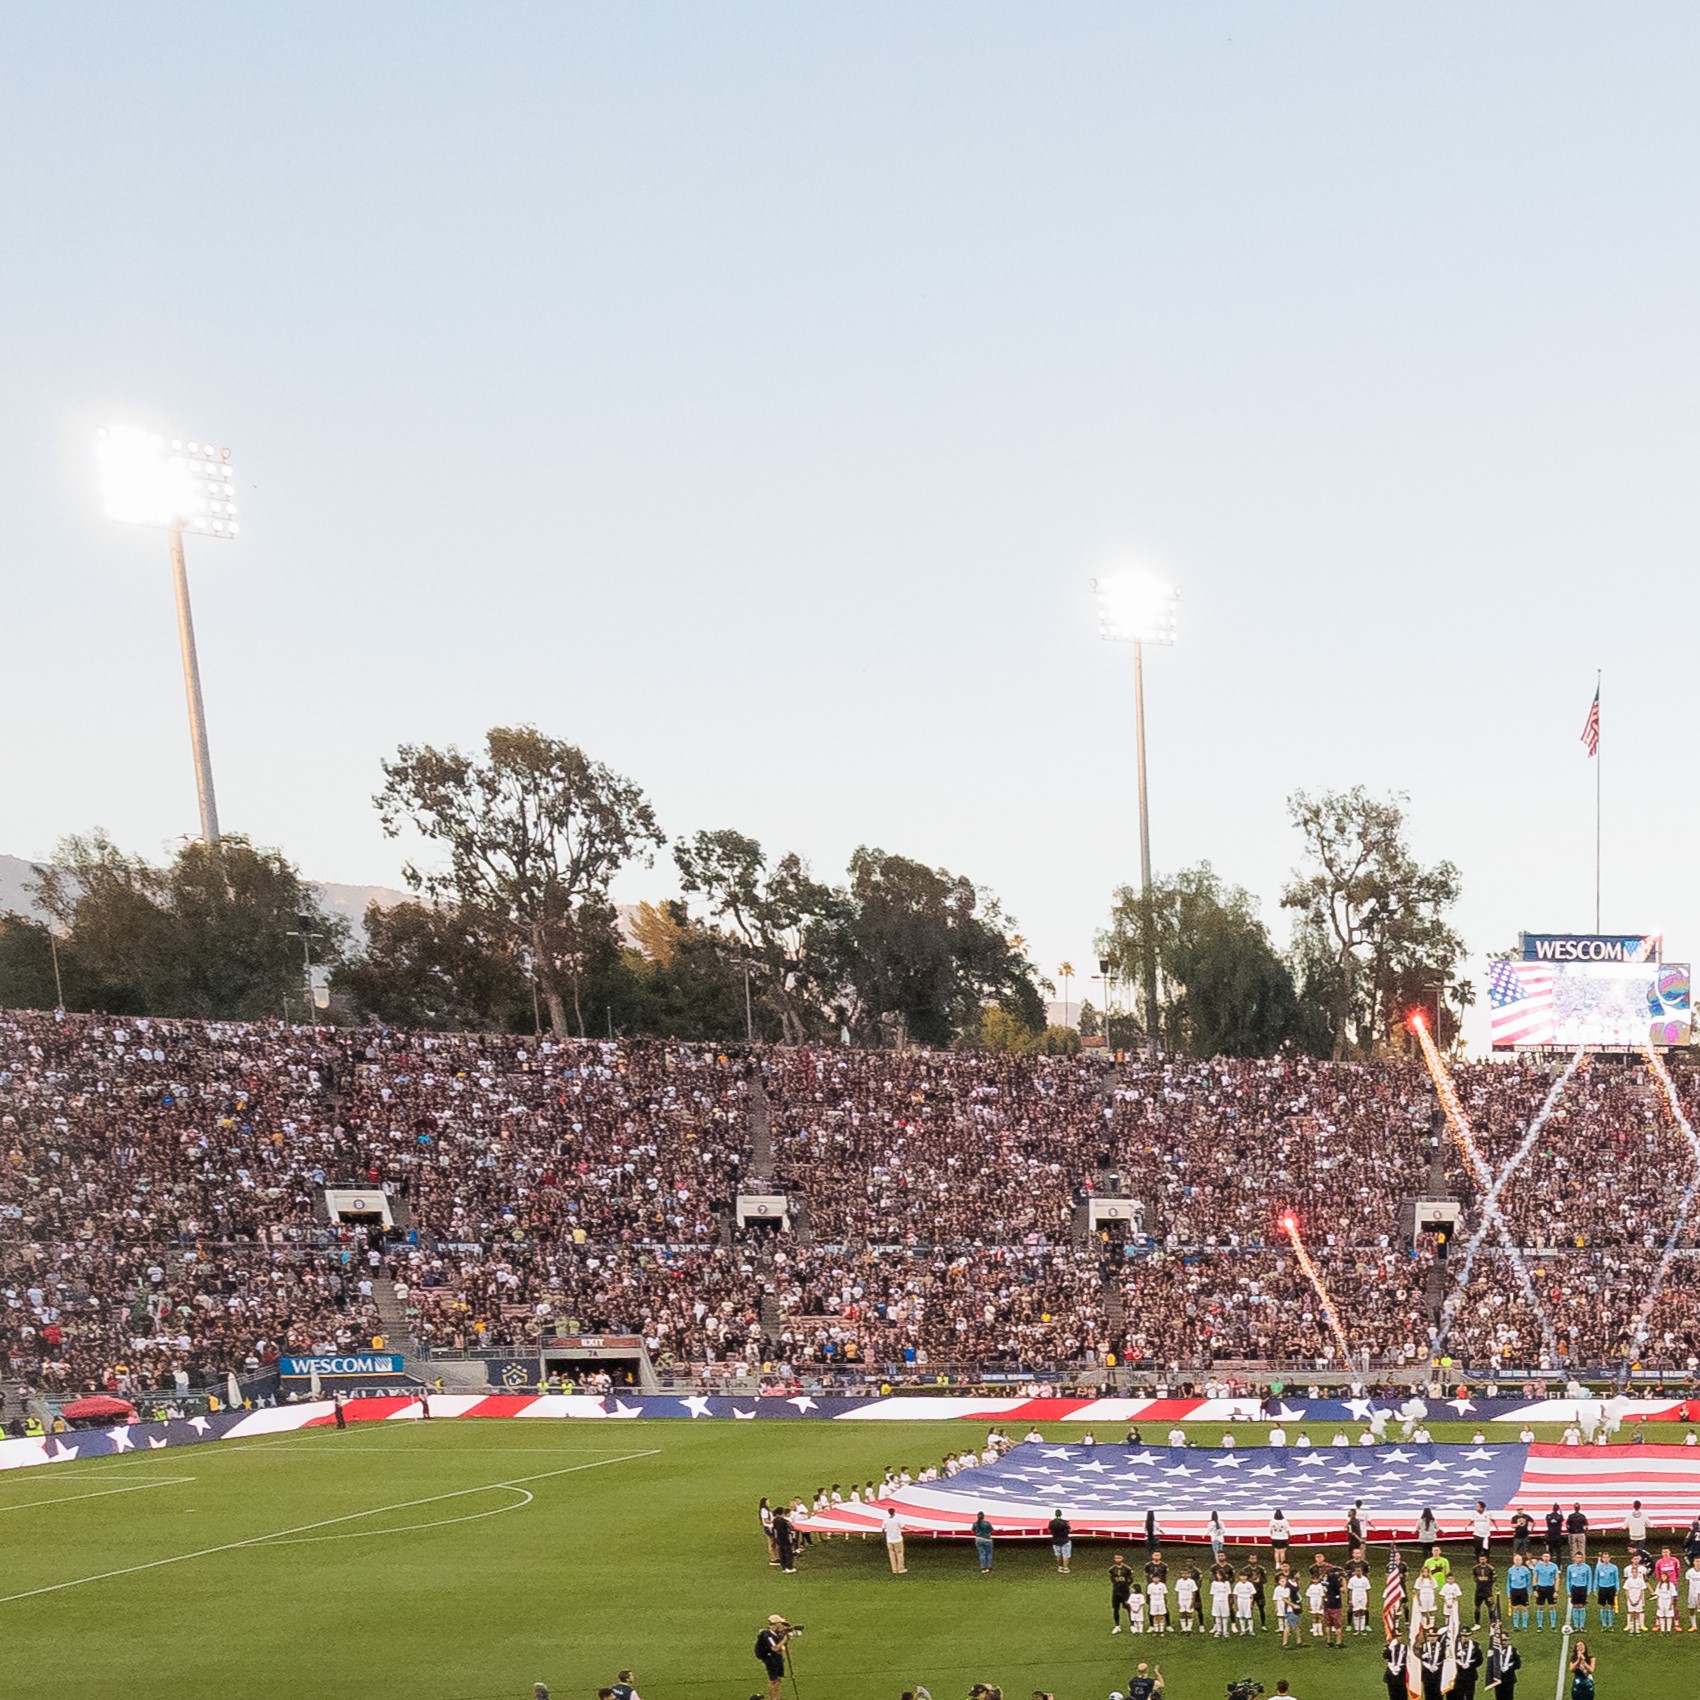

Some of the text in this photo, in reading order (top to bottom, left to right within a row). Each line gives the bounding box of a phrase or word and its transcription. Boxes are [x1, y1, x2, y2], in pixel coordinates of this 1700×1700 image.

[1535, 940, 1622, 961] WESCOM
[581, 1338, 604, 1347] EXIT
[291, 1357, 372, 1373] WESCOM
